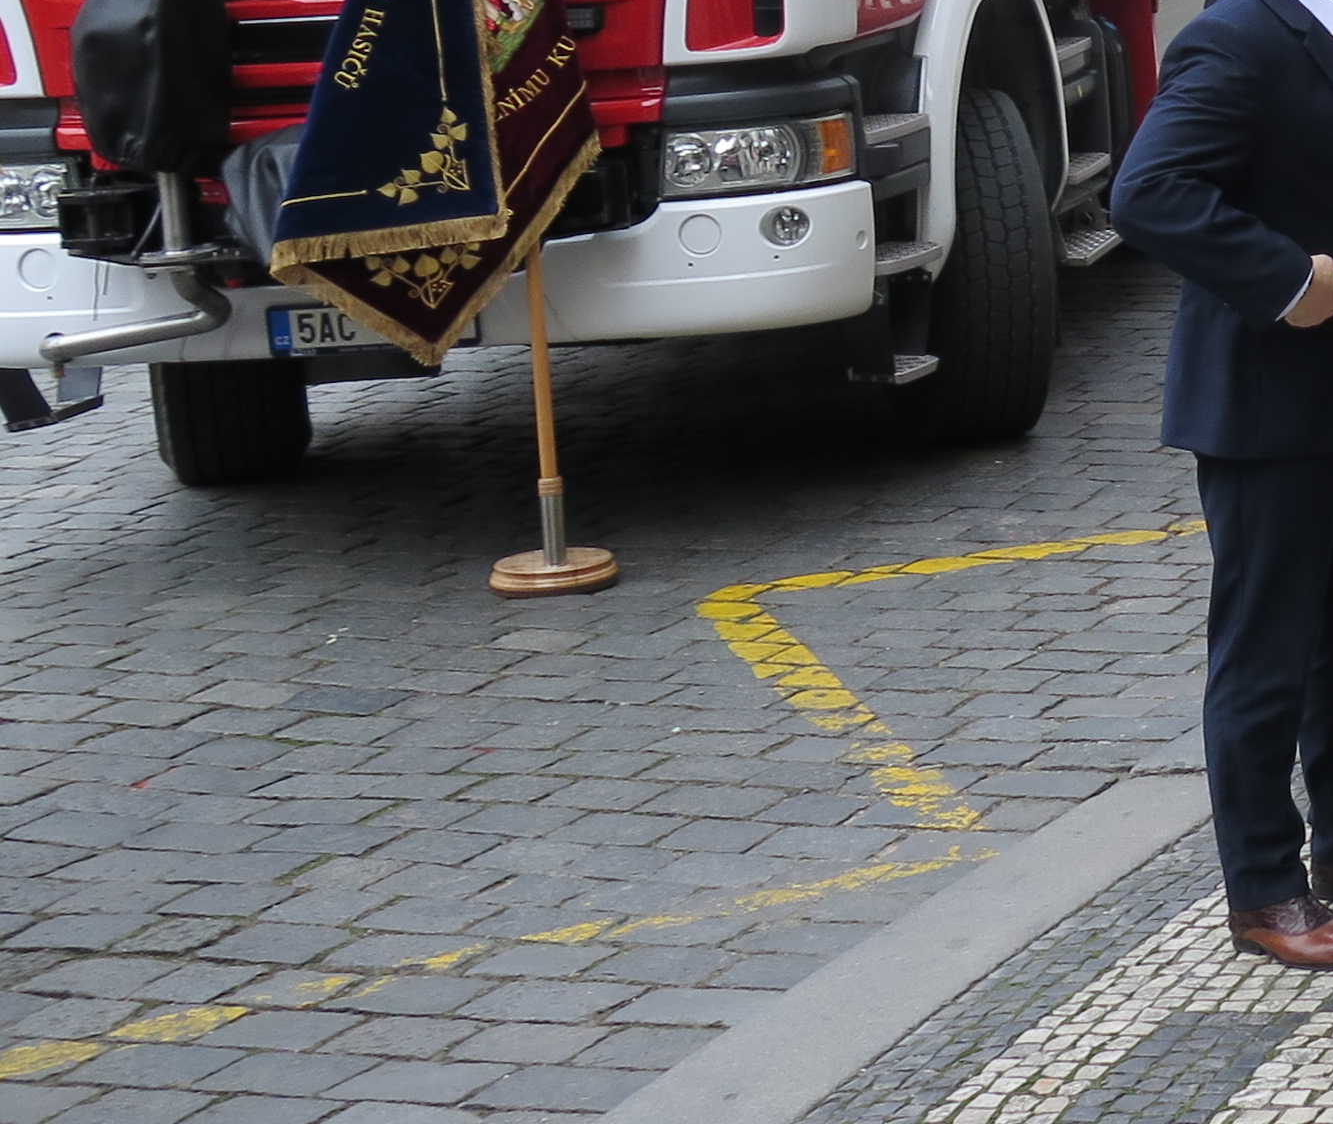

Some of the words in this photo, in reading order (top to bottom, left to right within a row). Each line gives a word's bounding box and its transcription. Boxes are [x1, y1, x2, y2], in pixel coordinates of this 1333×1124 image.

[333, 8, 385, 90] HASIČŮ
[494, 68, 550, 123] NÍMU
[545, 35, 576, 68] KU
